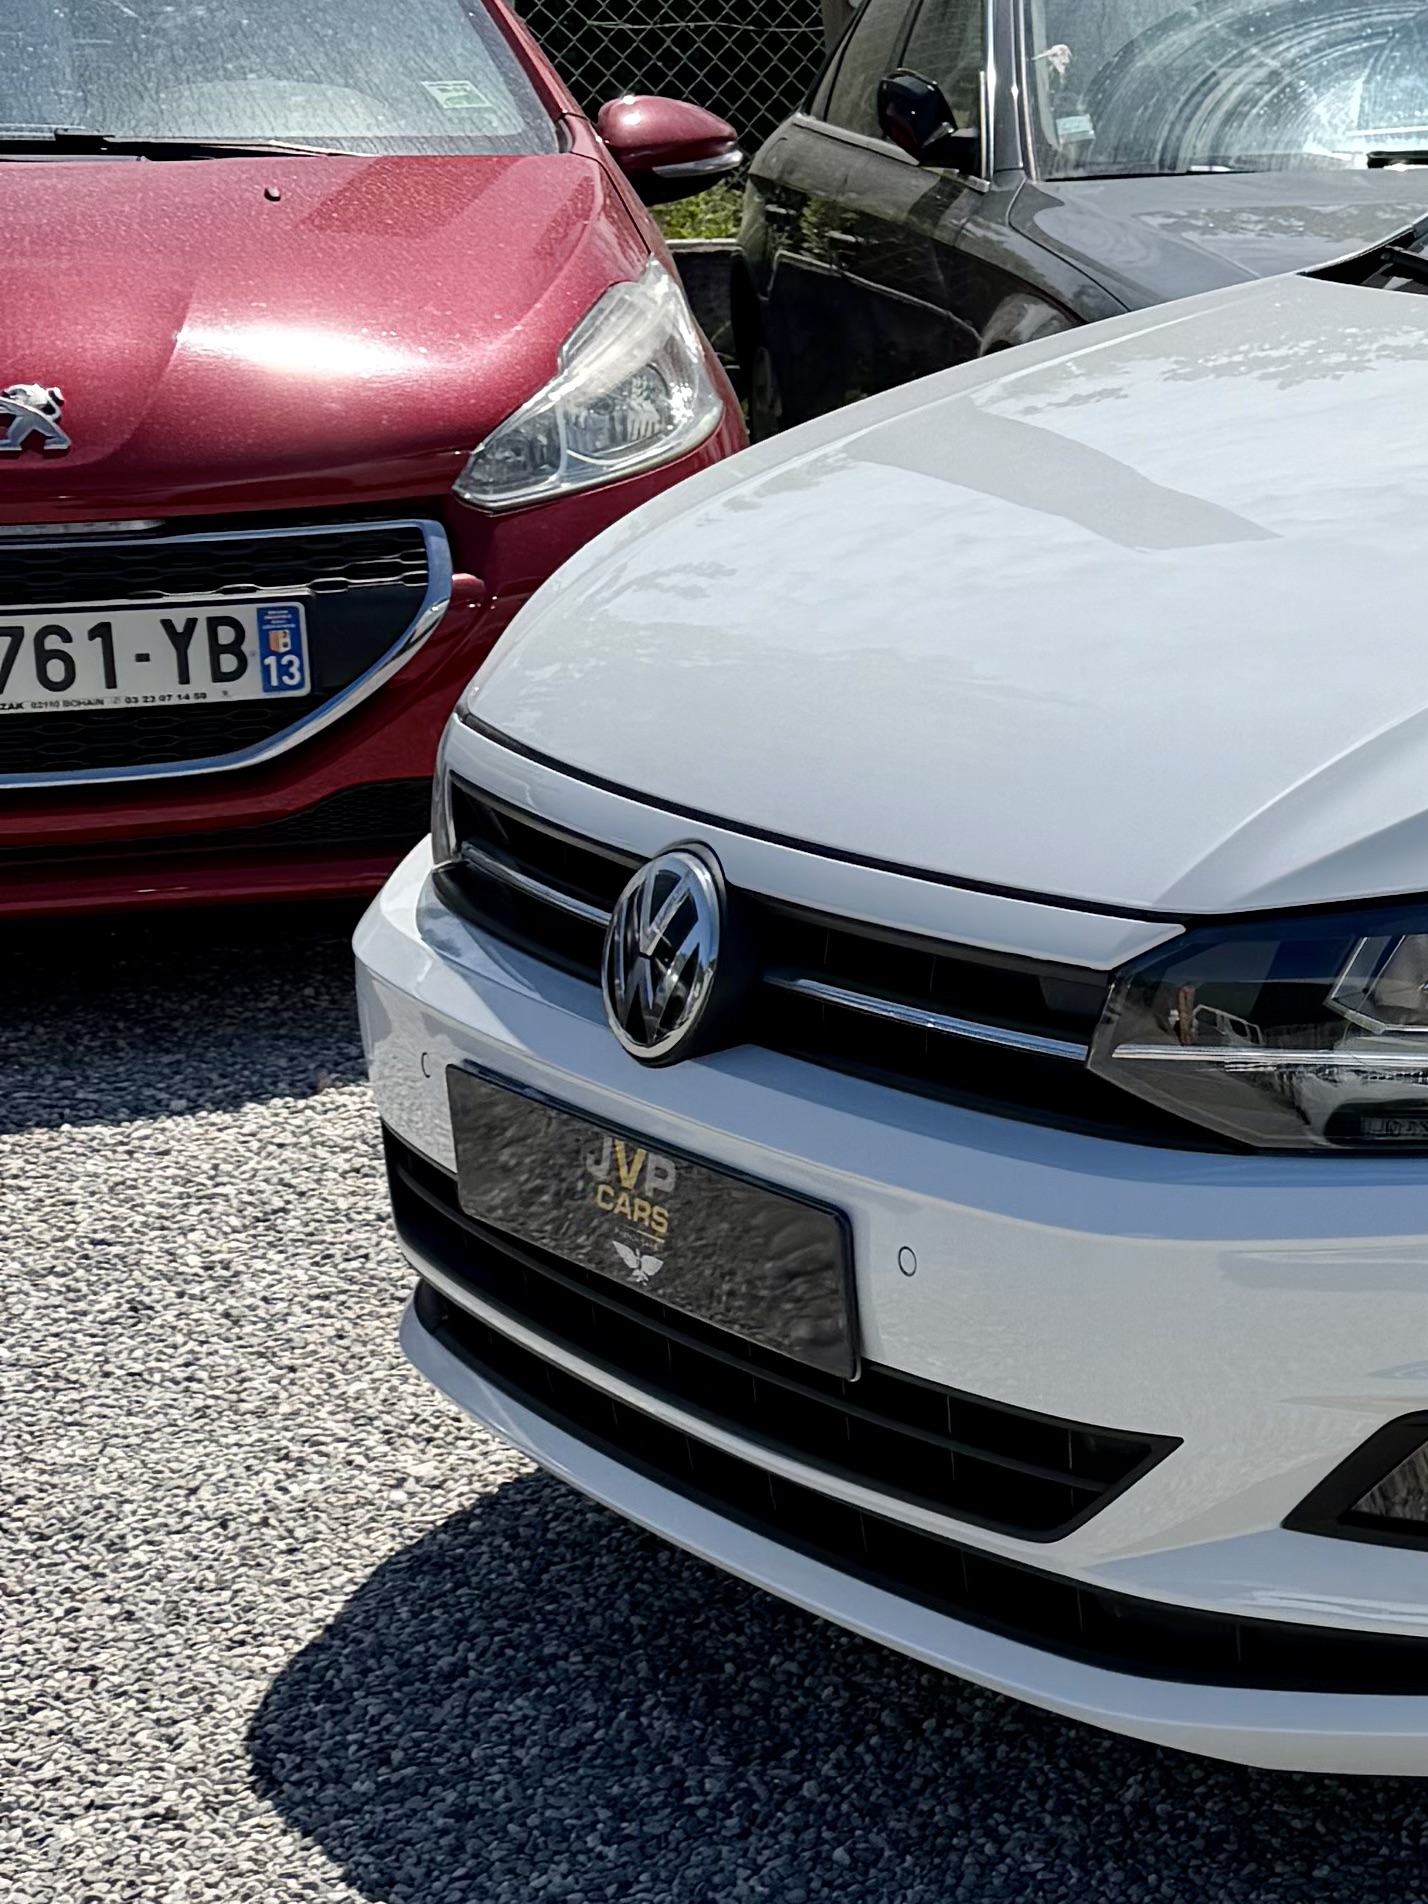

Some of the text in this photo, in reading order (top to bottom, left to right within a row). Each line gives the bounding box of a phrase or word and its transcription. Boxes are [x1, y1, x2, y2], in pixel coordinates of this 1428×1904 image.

[263, 654, 302, 687] 13
[585, 1135, 677, 1198] JVP
[596, 1182, 670, 1234] CARS
